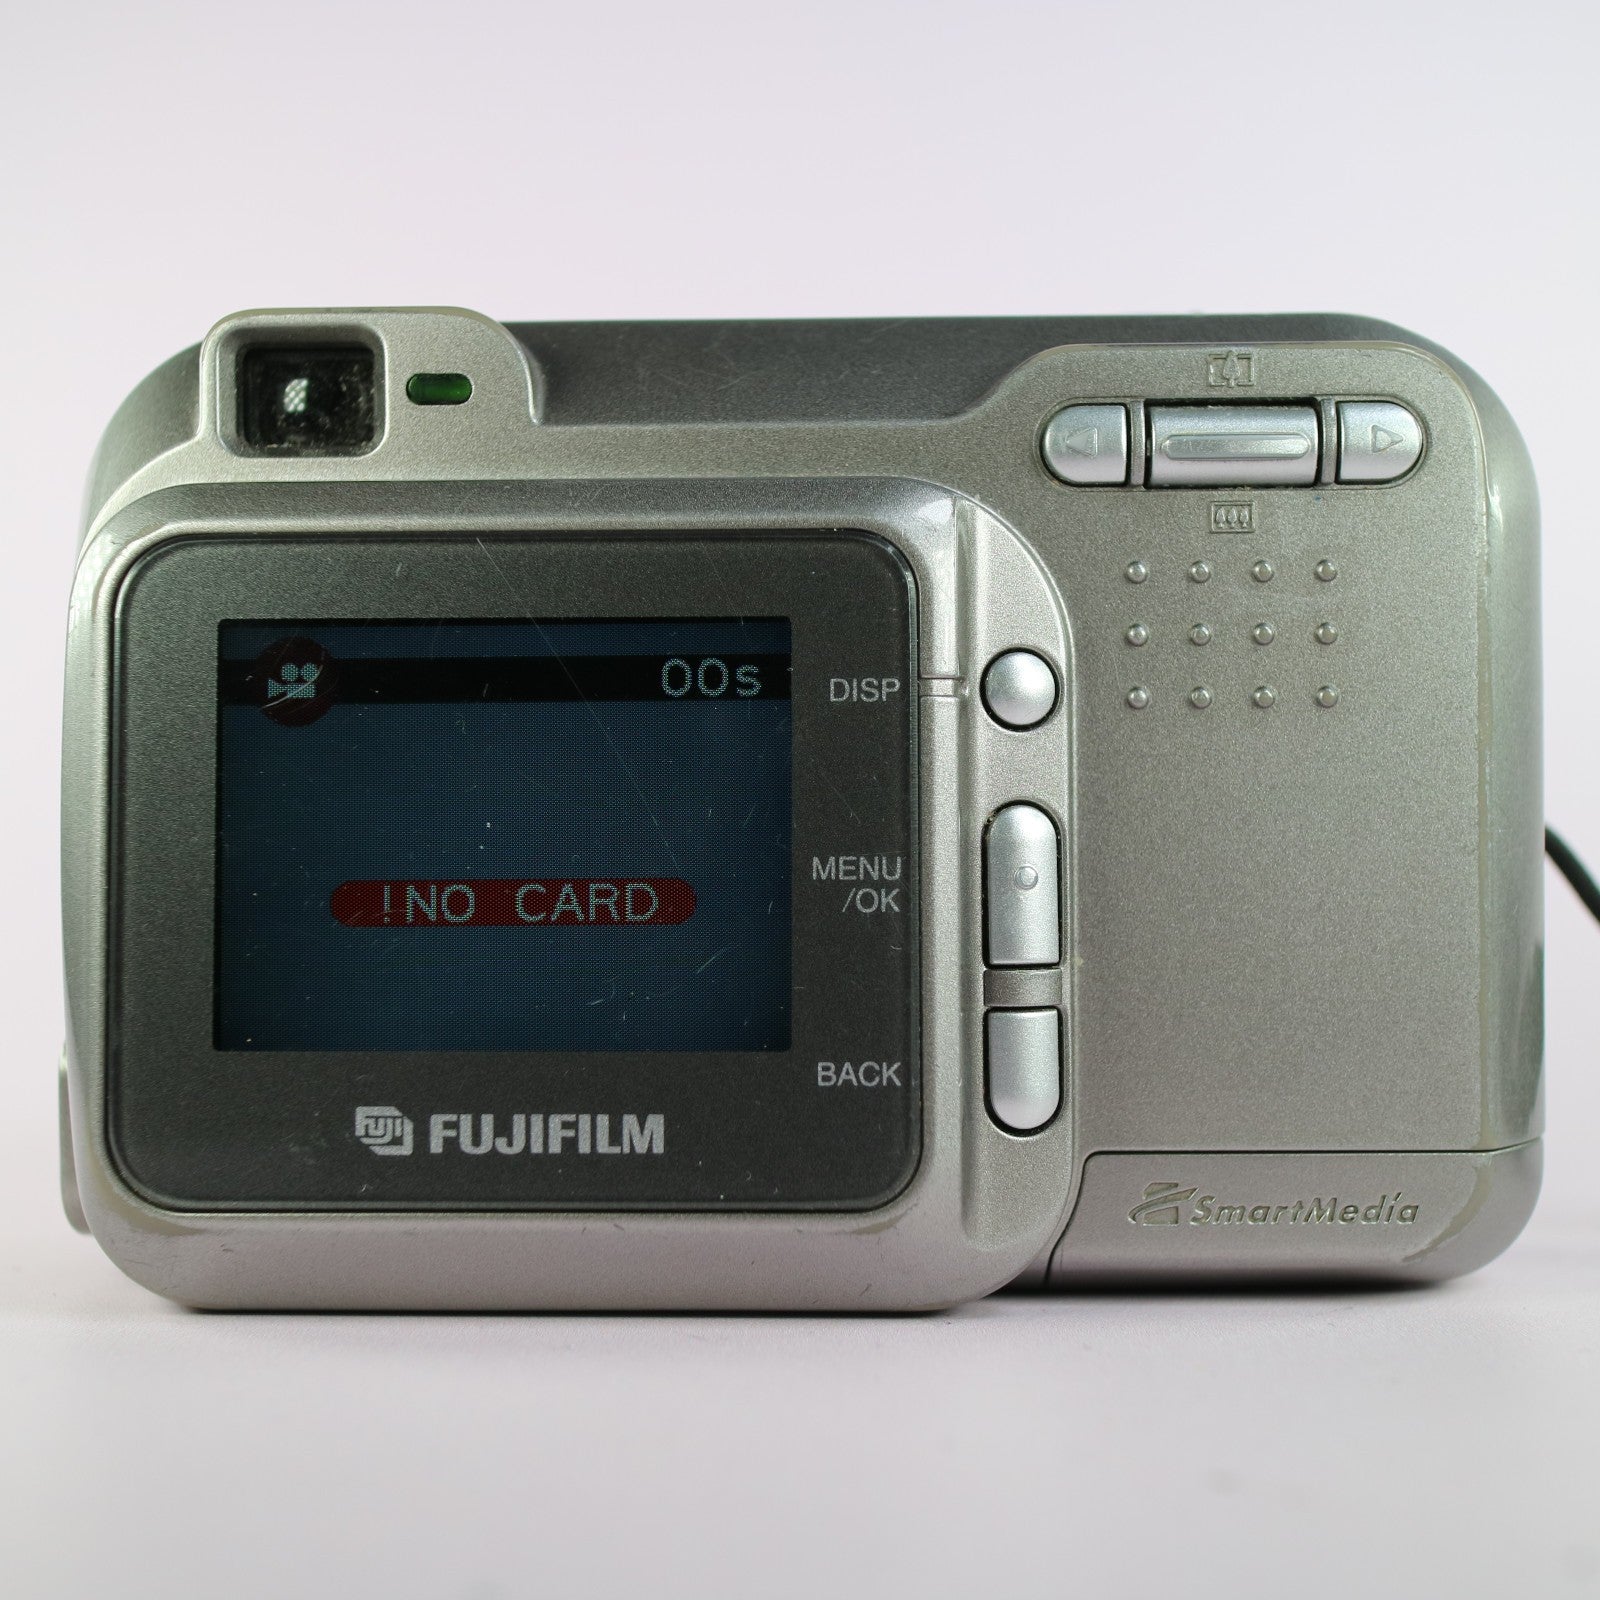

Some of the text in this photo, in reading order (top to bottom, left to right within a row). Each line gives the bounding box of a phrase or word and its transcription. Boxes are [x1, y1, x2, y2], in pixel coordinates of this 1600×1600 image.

[829, 677, 900, 702] DISP
[812, 855, 901, 881] MENU
[514, 883, 660, 922] CARD
[842, 887, 900, 914] /OK
[817, 1061, 902, 1087] BACK
[430, 1113, 665, 1155] FUJIFILM
[1190, 1192, 1419, 1226] SmartMedia
